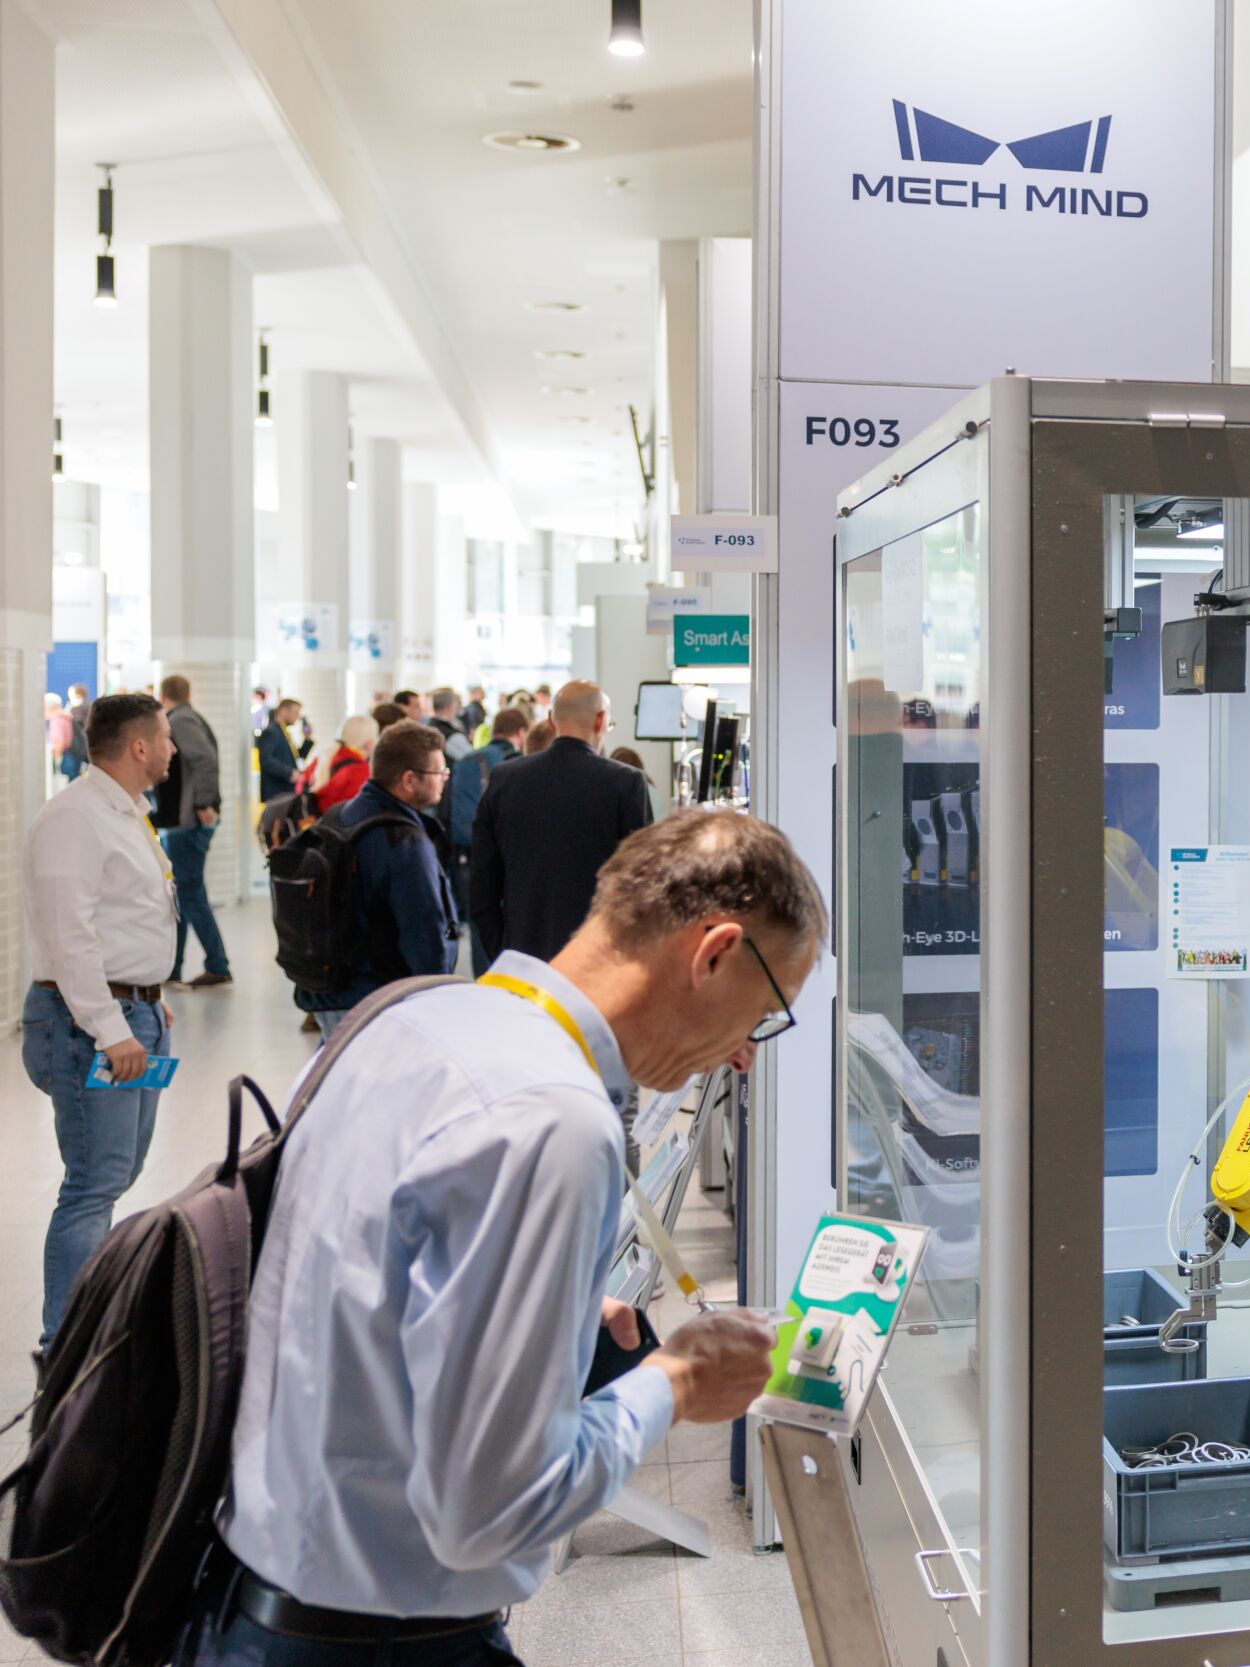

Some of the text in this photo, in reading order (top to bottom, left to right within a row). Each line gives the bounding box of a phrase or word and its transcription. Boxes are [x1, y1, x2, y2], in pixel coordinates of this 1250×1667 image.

[852, 173, 1149, 219] MECH MIND
[805, 416, 901, 449] F093
[714, 534, 756, 546] F-093
[684, 630, 728, 647] Smart
